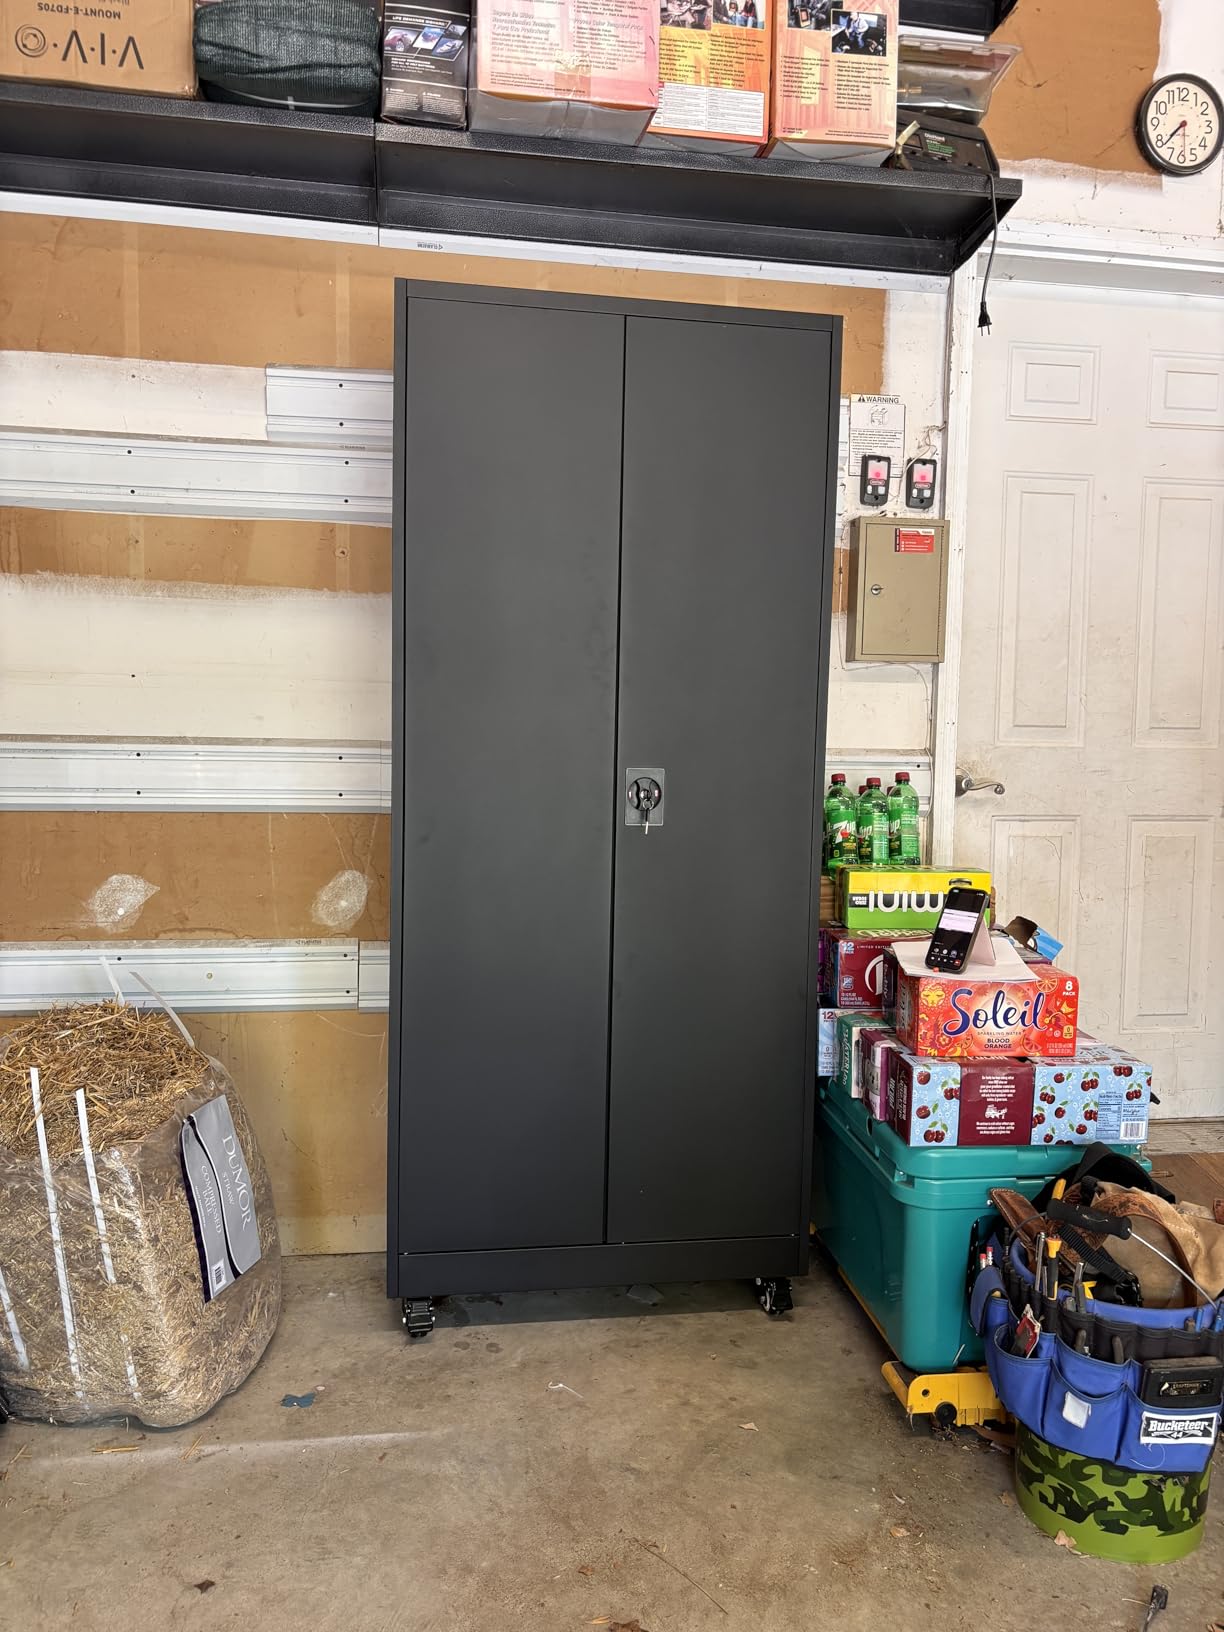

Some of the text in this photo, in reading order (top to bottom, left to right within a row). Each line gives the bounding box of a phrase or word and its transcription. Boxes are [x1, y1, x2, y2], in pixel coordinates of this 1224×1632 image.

[37, 2, 122, 20] MOUNT-E-FD70S
[1166, 89, 1175, 105] 11
[1176, 87, 1190, 102] 12
[1193, 92, 1198, 107] 1
[1154, 100, 1168, 116] 10
[1200, 101, 1209, 116] 2
[1150, 116, 1160, 131] 9
[1204, 119, 1213, 134] 3
[1155, 133, 1164, 149] 8
[1198, 136, 1208, 151] 4
[1166, 146, 1175, 161] 7
[1177, 150, 1186, 164] 6
[1189, 147, 1198, 162] 5
[866, 396, 900, 404] WARNING
[842, 941, 855, 951] 12
[1065, 981, 1073, 991] 8
[943, 988, 1048, 1037] Soleil
[201, 1165, 222, 1234] COMPRESSED
[1147, 1420, 1209, 1432] Bucketeer
